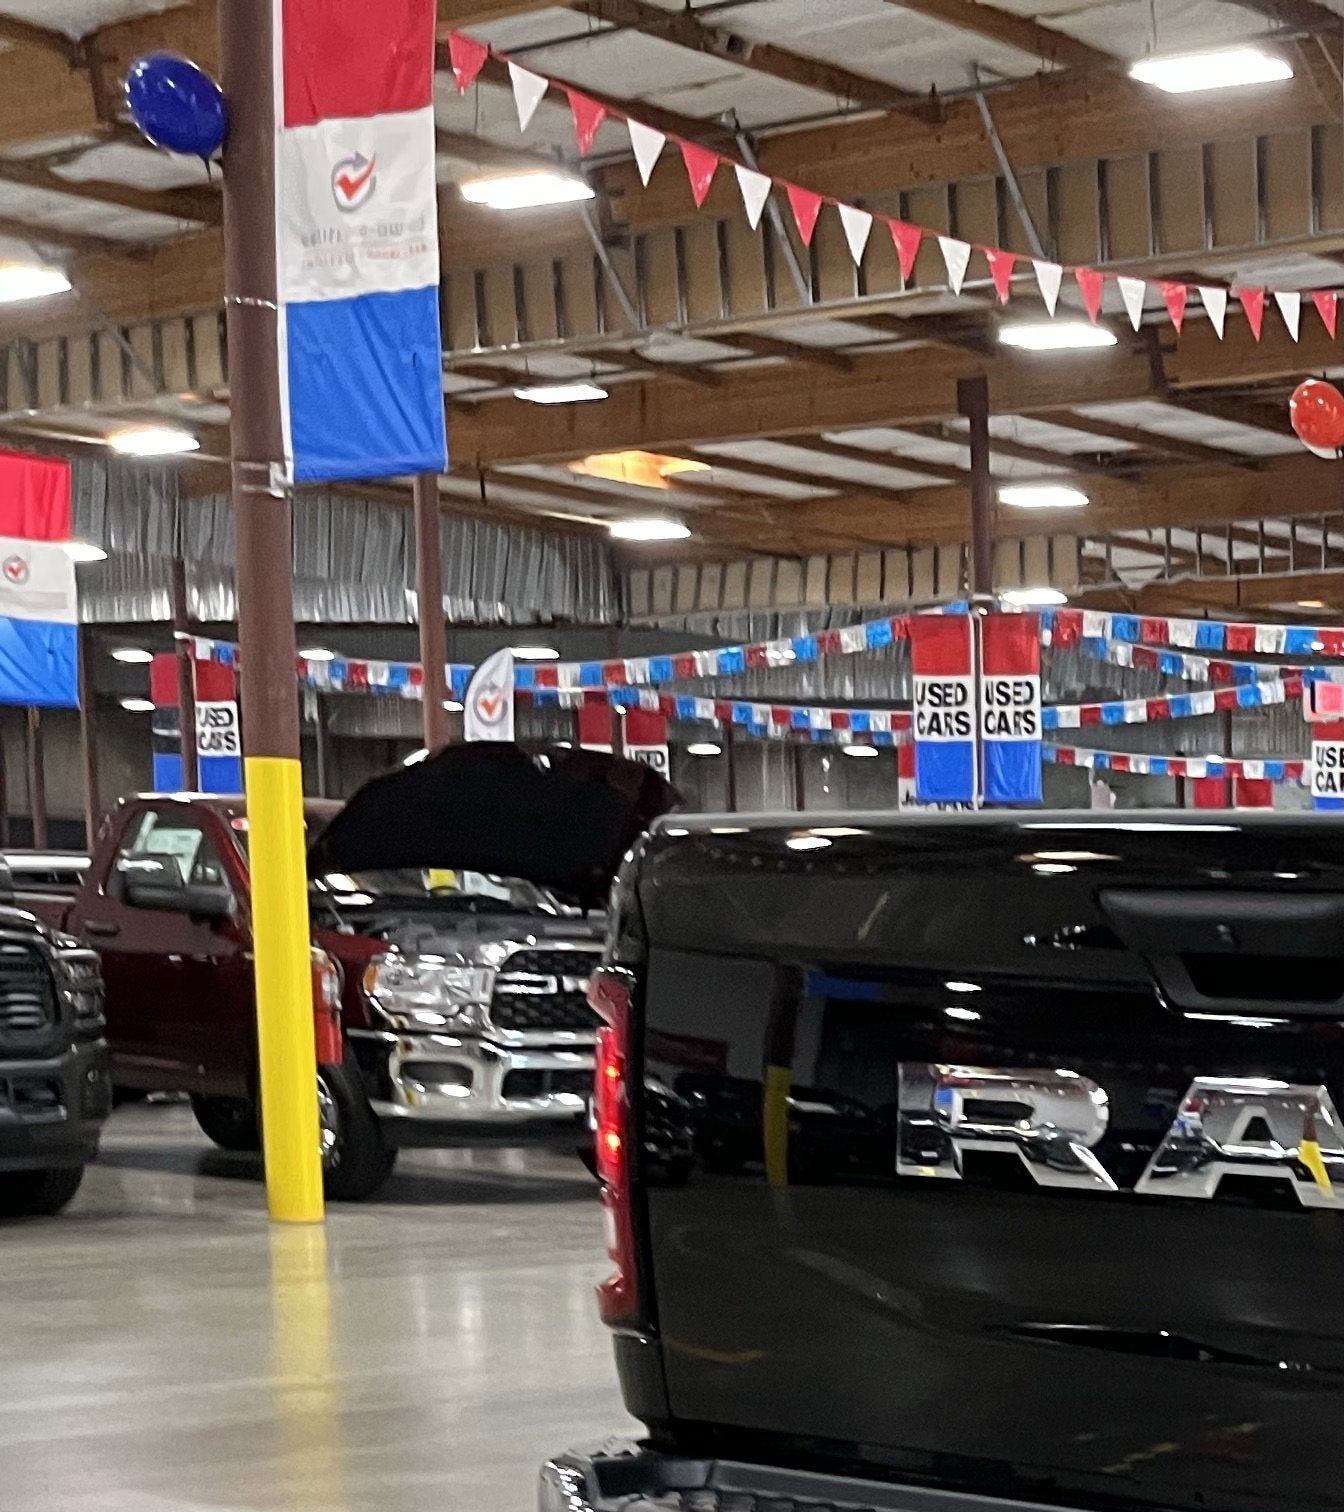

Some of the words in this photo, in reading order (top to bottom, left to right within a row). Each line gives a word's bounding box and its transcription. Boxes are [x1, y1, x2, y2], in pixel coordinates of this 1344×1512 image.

[916, 681, 968, 707] USED
[985, 680, 1034, 706] USED
[917, 710, 971, 736] CARS
[984, 709, 1036, 736] CARS
